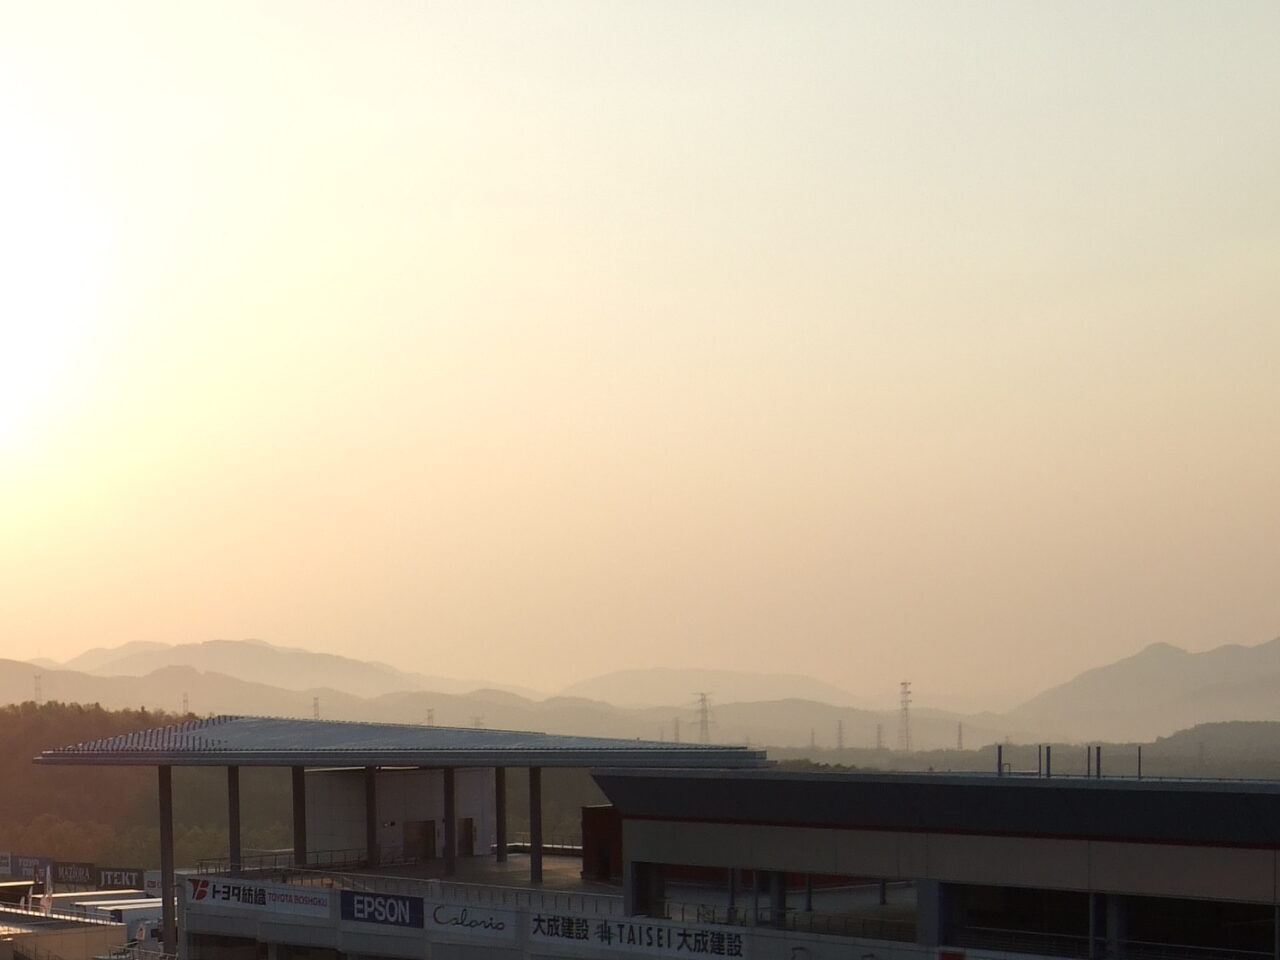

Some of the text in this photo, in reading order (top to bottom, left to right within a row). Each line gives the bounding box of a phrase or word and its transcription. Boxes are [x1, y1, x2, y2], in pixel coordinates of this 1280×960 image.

[100, 871, 139, 887] JTEKT
[212, 884, 328, 907] トヨタ紡織 TOYOTA BOSHOKU
[353, 896, 410, 923] EPSON
[532, 914, 743, 957] 大成建設 TAISEI 大成建設
